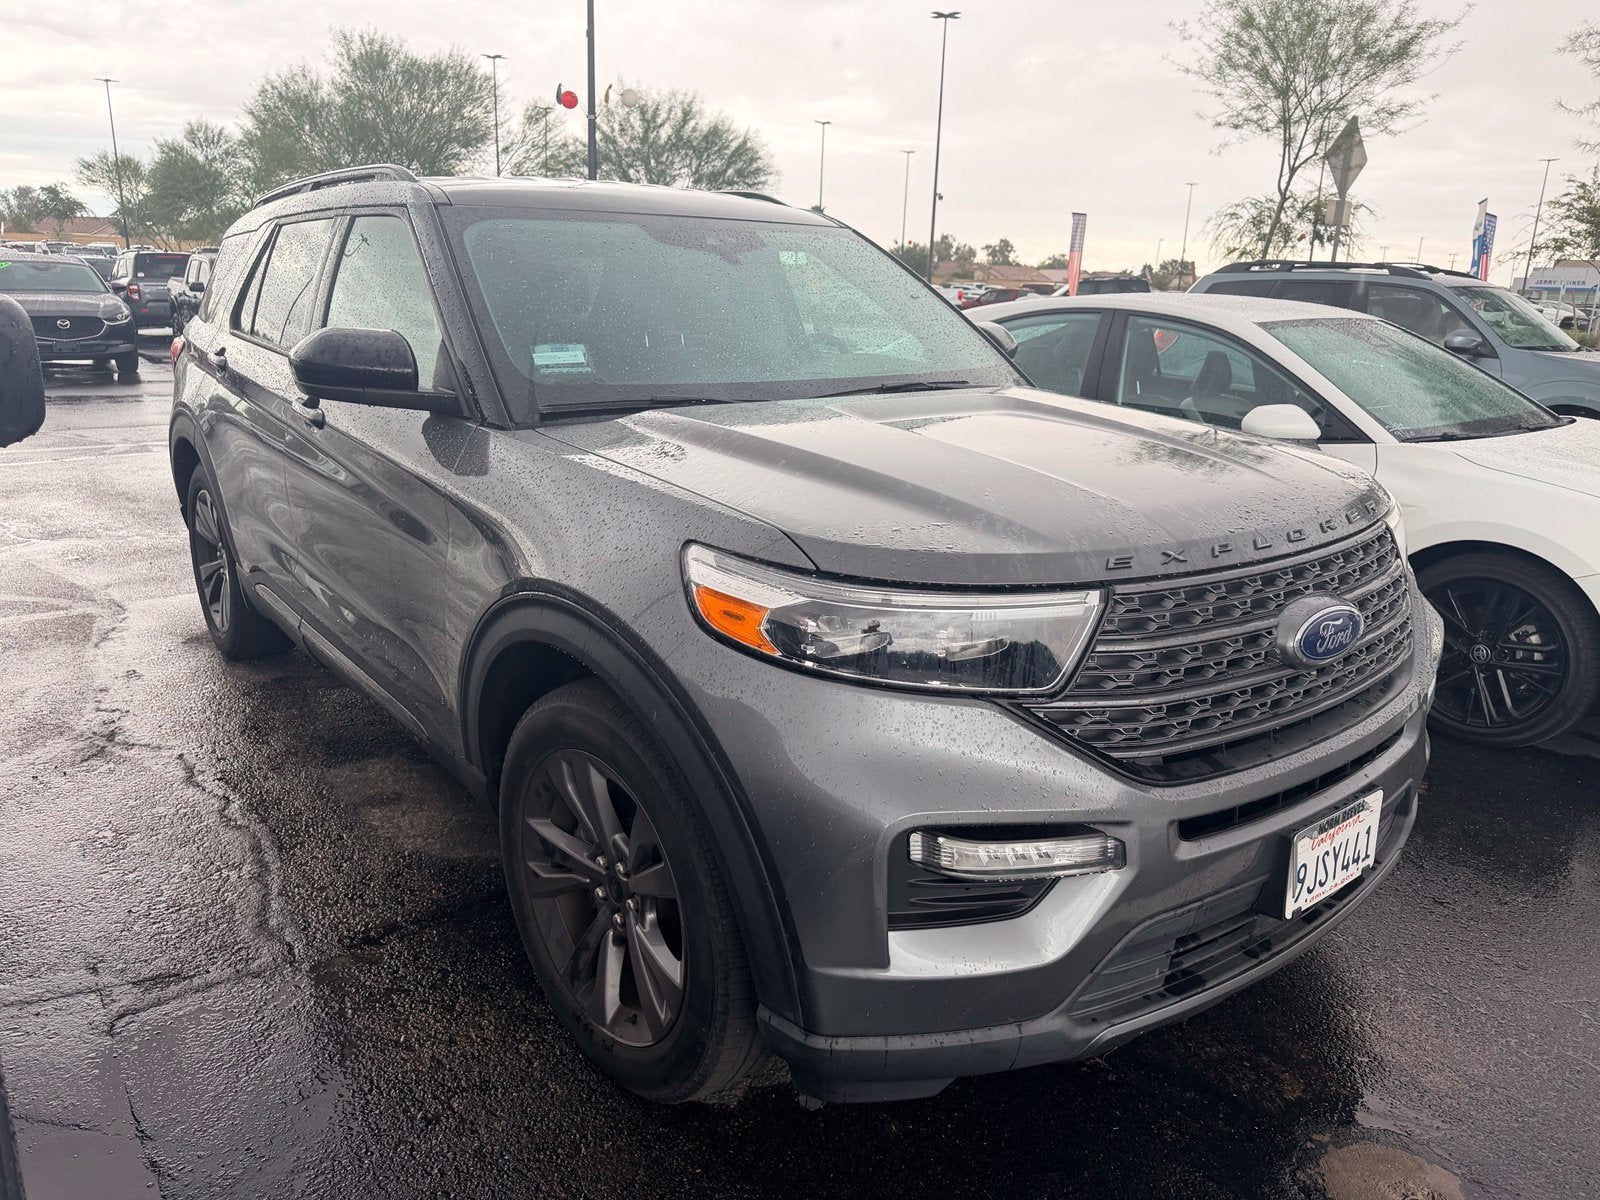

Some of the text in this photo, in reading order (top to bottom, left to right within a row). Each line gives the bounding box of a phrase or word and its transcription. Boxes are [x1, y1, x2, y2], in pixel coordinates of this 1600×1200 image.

[1107, 500, 1379, 571] EXPLORER
[1316, 618, 1353, 653] Ford
[1311, 814, 1366, 851] California
[1294, 825, 1372, 904] 9JSY441
[1309, 871, 1355, 903] dmv.ca.gov
